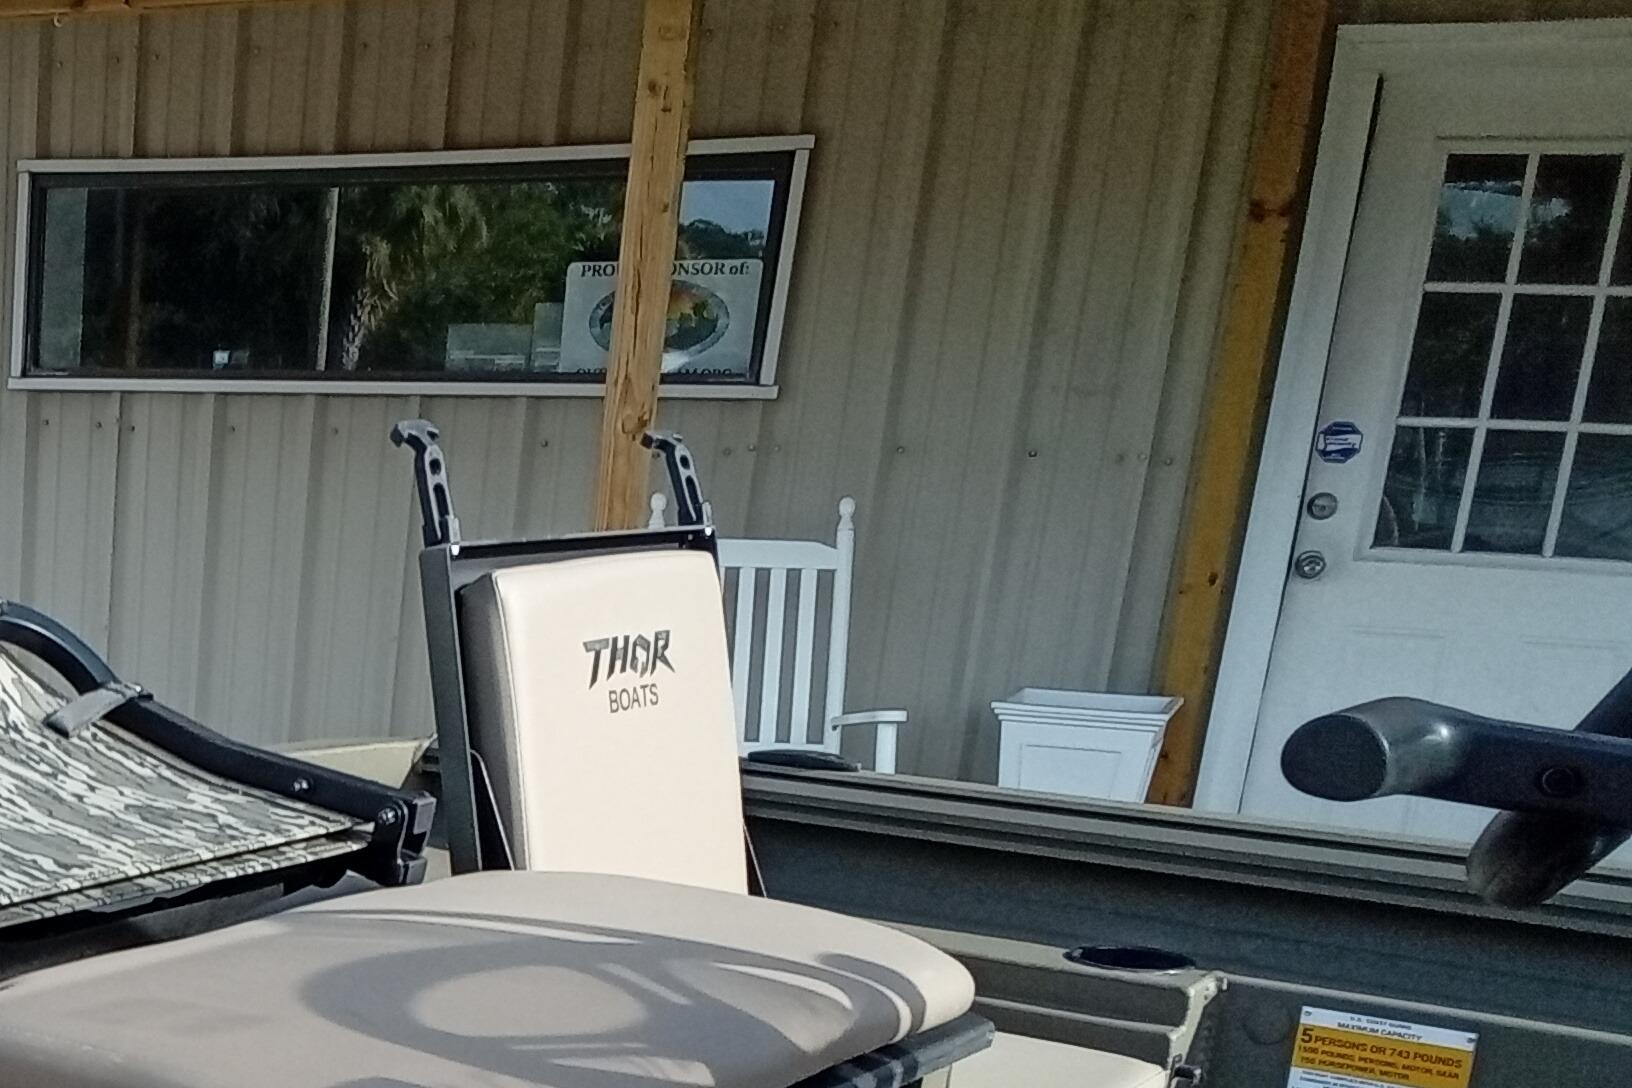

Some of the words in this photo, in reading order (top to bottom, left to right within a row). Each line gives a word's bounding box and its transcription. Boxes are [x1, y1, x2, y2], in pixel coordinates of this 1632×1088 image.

[581, 261, 618, 278] PRO
[671, 261, 725, 277] ONSOR
[729, 261, 750, 277] of:
[582, 629, 676, 690] THOR
[608, 683, 659, 713] BOATS
[1337, 1022, 1379, 1034] MAXIMUM
[1380, 1028, 1424, 1041] CAPACITY
[1300, 1028, 1314, 1044] 5
[1314, 1036, 1368, 1053] PERSONS
[1369, 1044, 1387, 1056] OR
[1413, 1051, 1464, 1069] POUNDS
